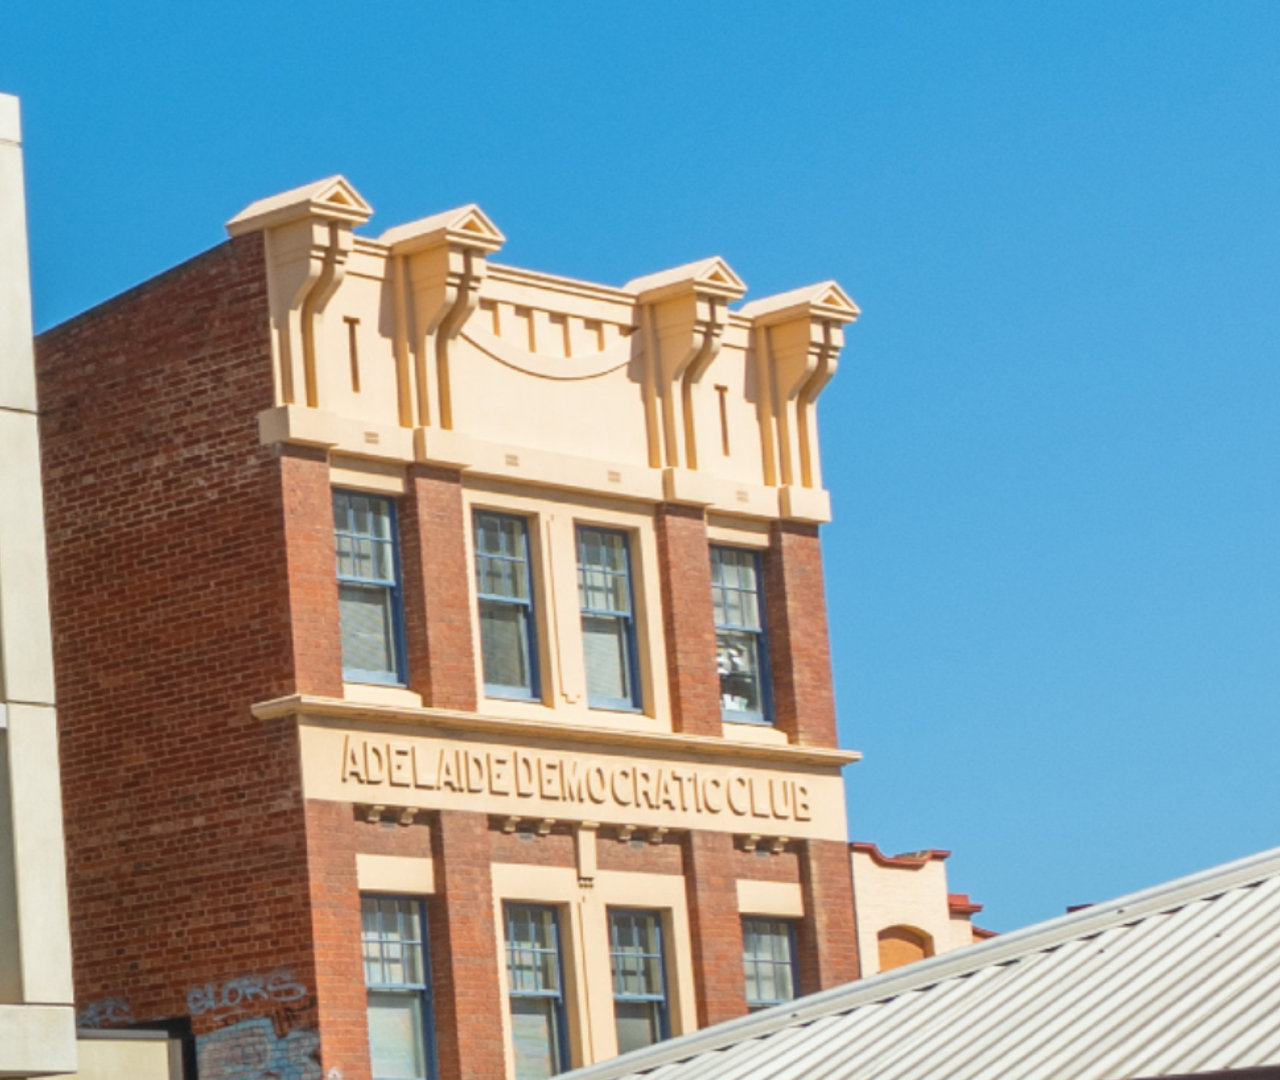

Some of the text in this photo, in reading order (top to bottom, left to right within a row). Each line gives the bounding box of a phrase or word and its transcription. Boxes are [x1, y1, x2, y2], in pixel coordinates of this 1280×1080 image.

[341, 734, 813, 822] ADELAIDE DEMOCRATIC CLUB
